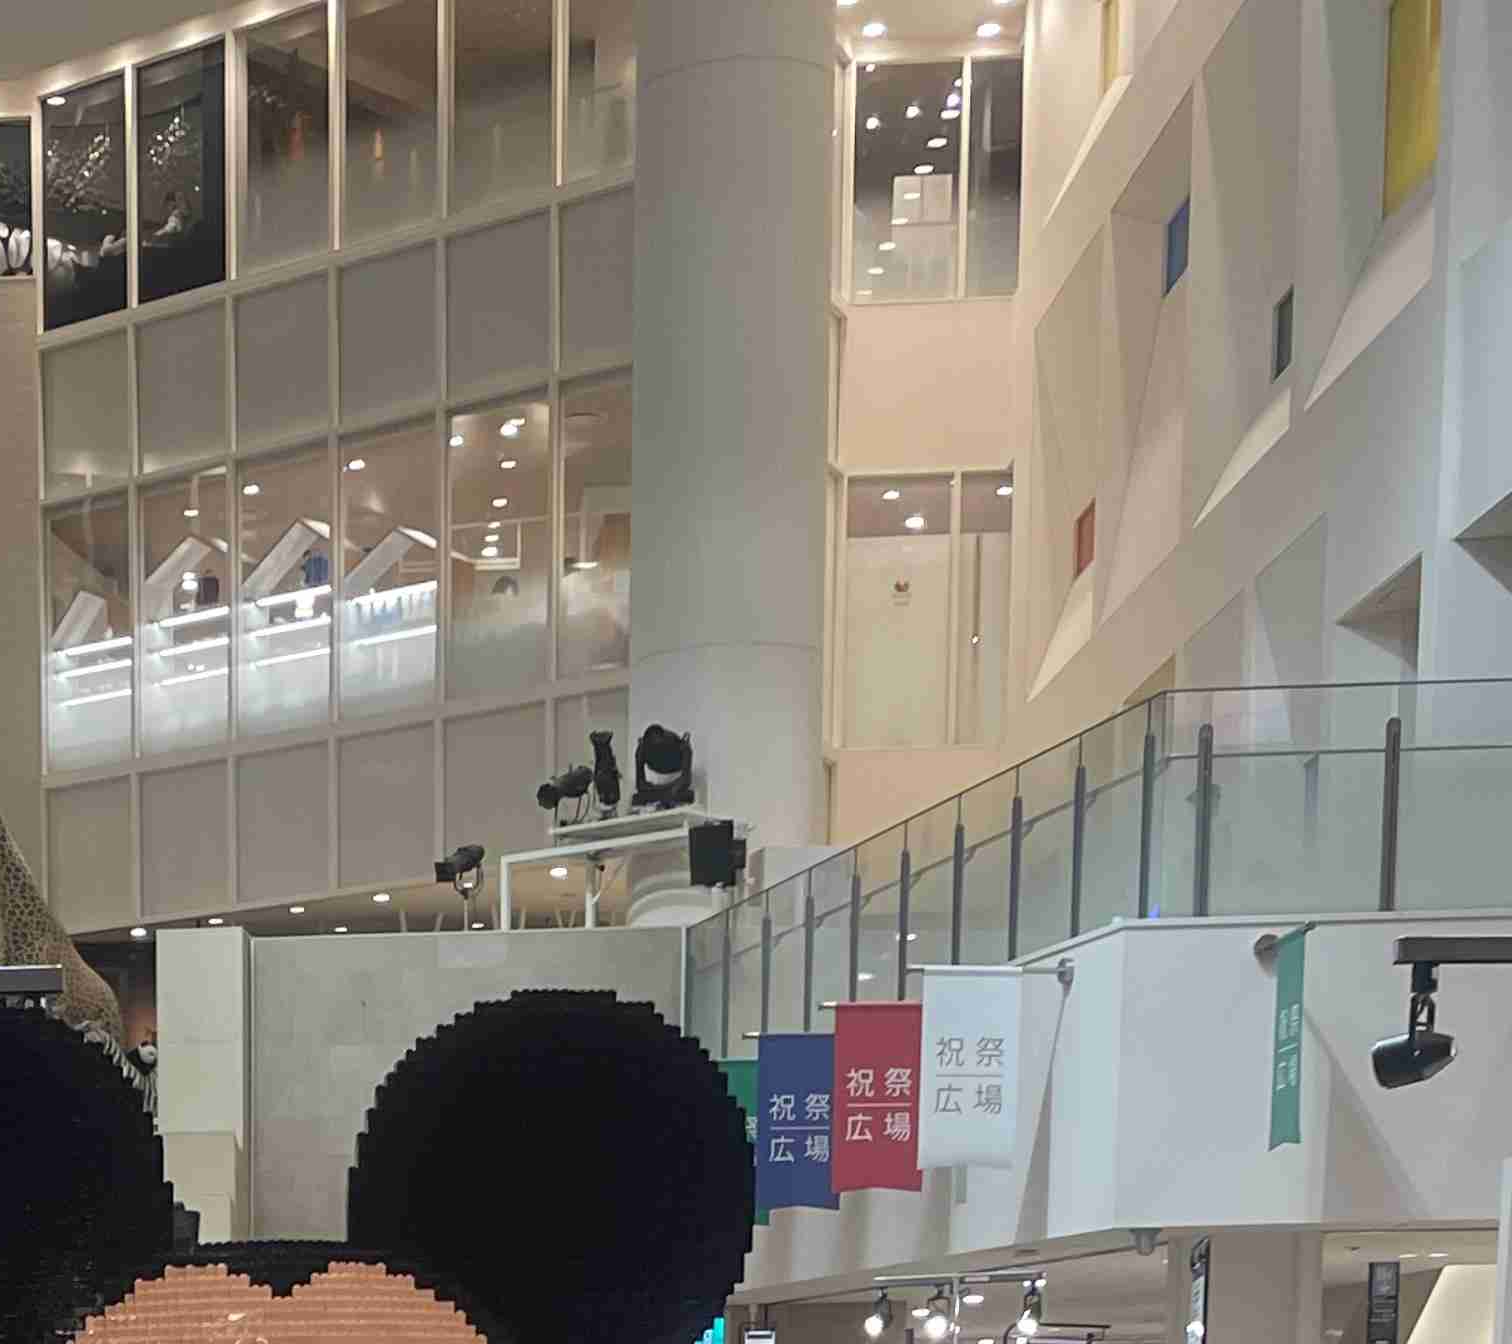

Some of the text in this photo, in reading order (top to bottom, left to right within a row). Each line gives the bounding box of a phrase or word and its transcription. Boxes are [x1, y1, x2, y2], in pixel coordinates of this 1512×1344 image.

[935, 1037, 1005, 1068] 祝祭
[845, 1067, 913, 1098] 祝祭
[768, 1093, 831, 1122] 祝祭
[934, 1083, 1003, 1115] 広場
[845, 1112, 912, 1142] 広場
[768, 1135, 830, 1163] 広場
